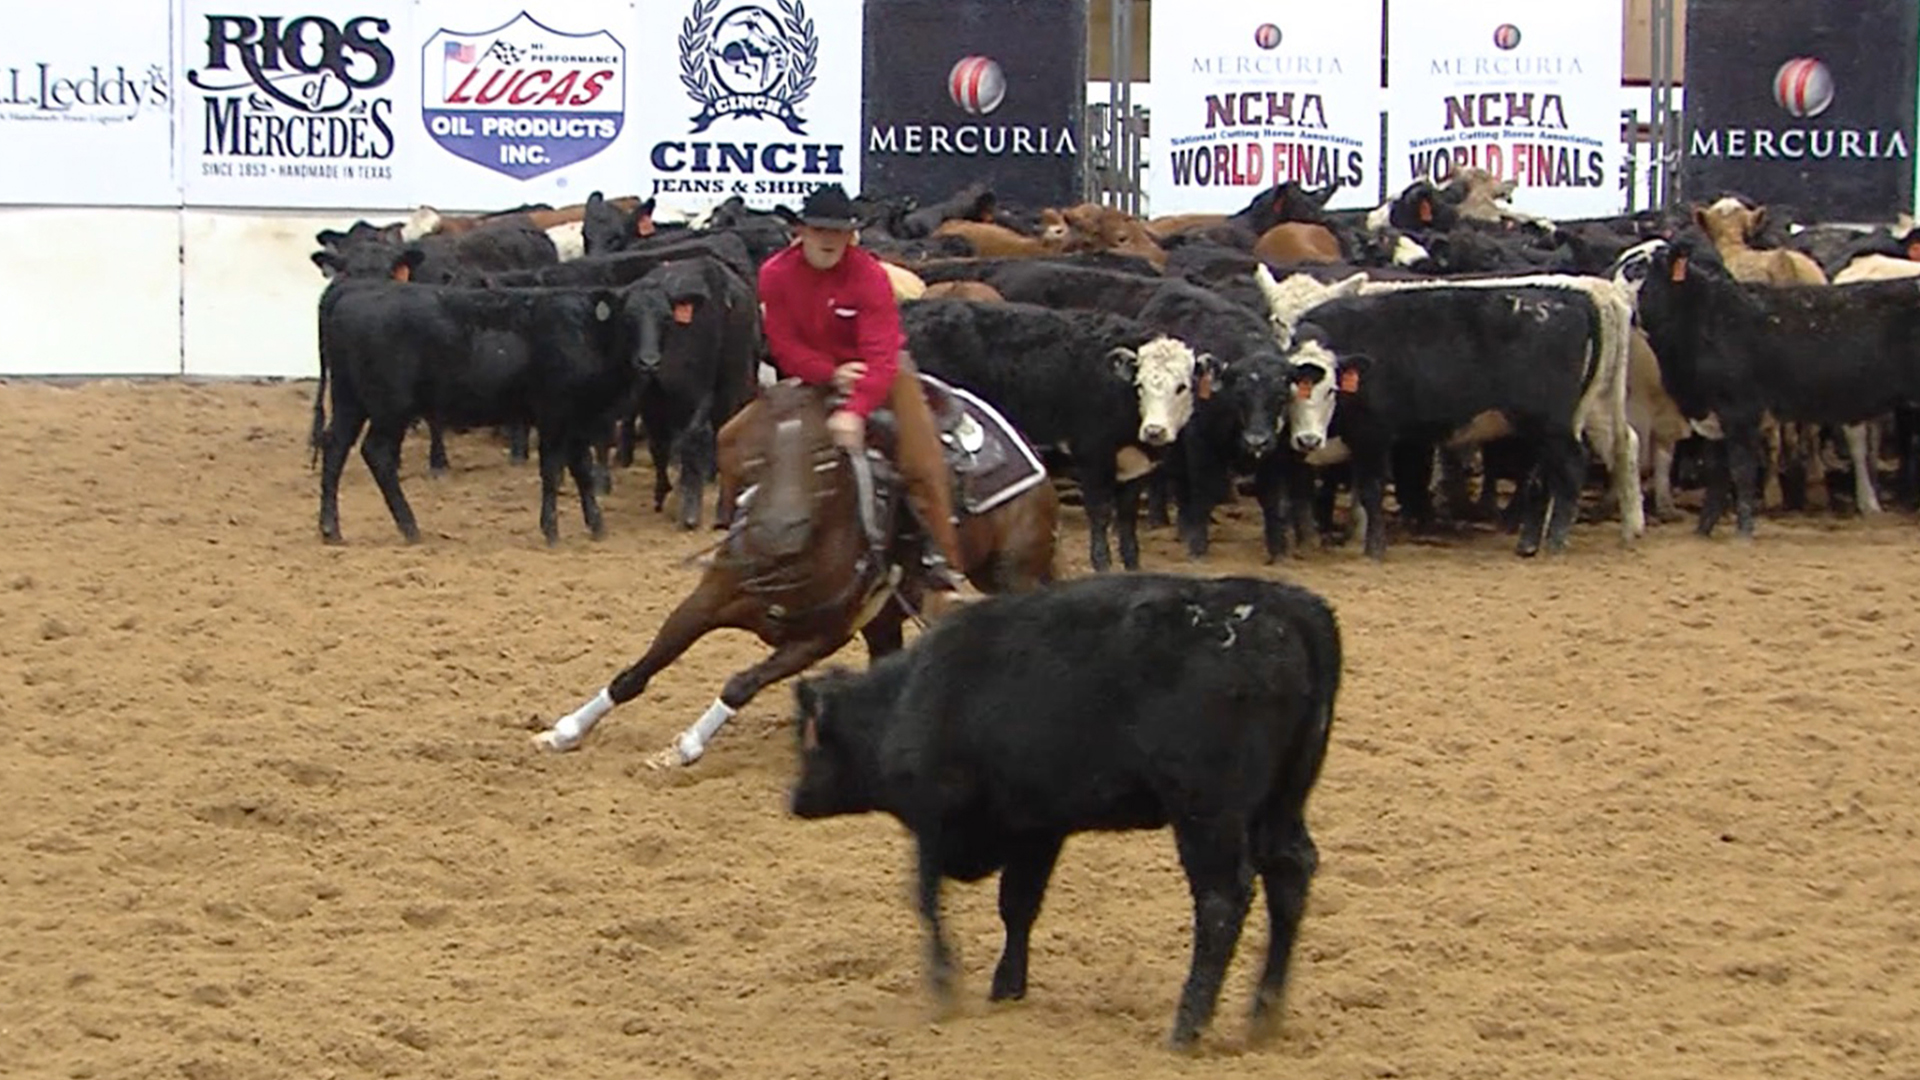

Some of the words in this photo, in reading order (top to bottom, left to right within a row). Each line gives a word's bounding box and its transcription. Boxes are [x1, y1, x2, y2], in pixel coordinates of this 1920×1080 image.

[200, 14, 395, 91] RIOS
[531, 54, 618, 63] PERFORMANCE
[1192, 56, 1343, 74] MERCURIA
[1431, 57, 1583, 75] MERCURIA
[301, 72, 332, 108] of
[444, 66, 614, 106] LUCAS
[715, 94, 780, 116] CINCH
[1205, 91, 1328, 129] NCHA
[1444, 92, 1568, 130] NCHA
[203, 97, 395, 160] MERCEDES
[431, 116, 474, 136] OIL
[481, 117, 616, 138] PRODUCTS
[869, 125, 1077, 154] MERCURIA
[1170, 132, 1217, 146] National
[1220, 129, 1260, 140] Cutting
[1264, 129, 1295, 138] Horse
[1299, 131, 1363, 147] Association
[1409, 133, 1456, 148] National
[1459, 130, 1499, 140] Cutting
[1503, 129, 1534, 139] Horse
[1539, 131, 1603, 147] Association
[500, 144, 551, 164] INC.
[650, 141, 844, 174] CINCH
[1691, 128, 1908, 158] MERCURIA
[202, 162, 233, 177] SINCE
[239, 163, 267, 177] 1853
[279, 164, 338, 178] HANDMADE
[343, 165, 354, 178] IN
[358, 166, 392, 179] TEXAS
[1170, 143, 1264, 187] WORLD
[1273, 142, 1363, 187] FINALS
[1512, 143, 1604, 187] FINALS
[652, 179, 724, 195] JEANS
[731, 180, 749, 194] &
[755, 180, 842, 195] SHIR
